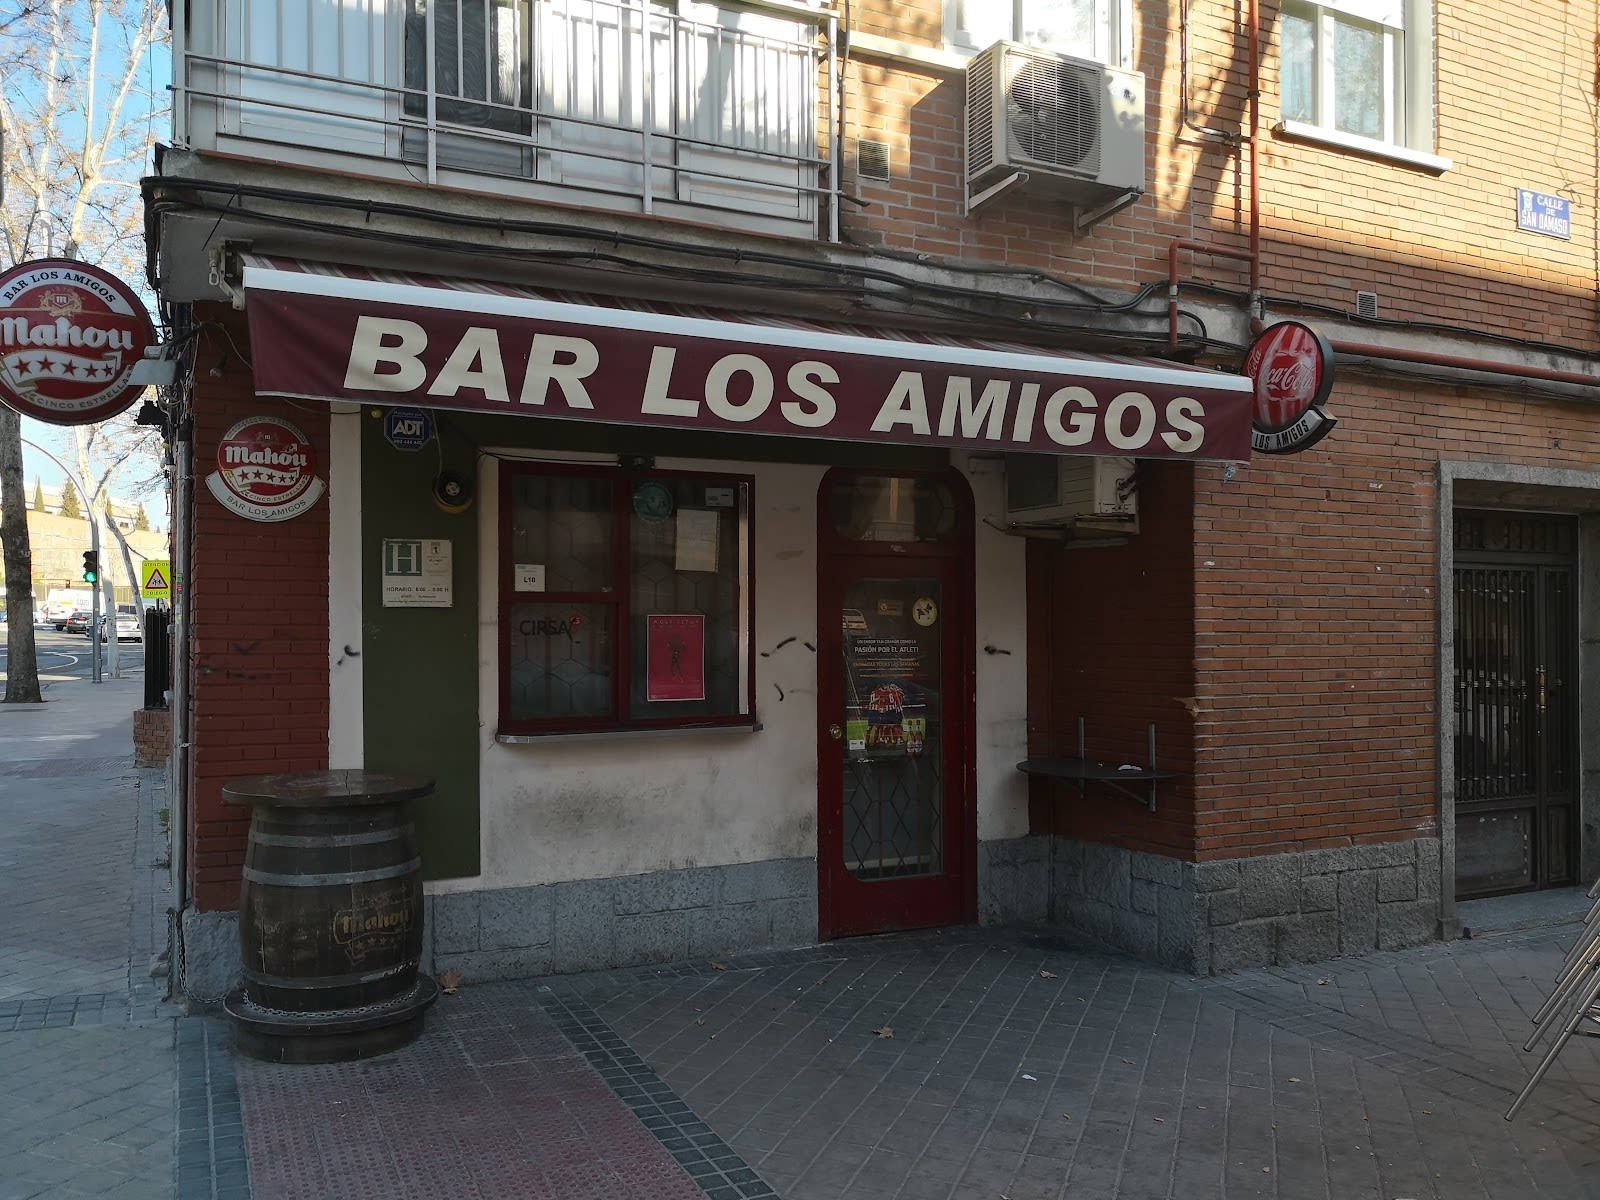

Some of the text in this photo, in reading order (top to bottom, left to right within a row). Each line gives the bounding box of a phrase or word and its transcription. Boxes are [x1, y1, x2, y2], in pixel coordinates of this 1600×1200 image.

[1537, 195, 1564, 211] CALLE
[1545, 208, 1556, 216] DE
[1521, 210, 1537, 228] SAN
[3, 271, 117, 303] BAR LOS AMIGOS
[0, 316, 135, 351] Mahou
[343, 315, 1206, 454] BAR LOS AMIGOS
[37, 397, 74, 409] CINCO
[393, 419, 424, 436] ADT
[1254, 419, 1310, 450] LOS AMIGOS
[225, 446, 308, 467] Mahou
[226, 498, 306, 517] BAR LOS AMIGOS
[388, 543, 421, 574] H
[519, 619, 570, 636] CIRSA
